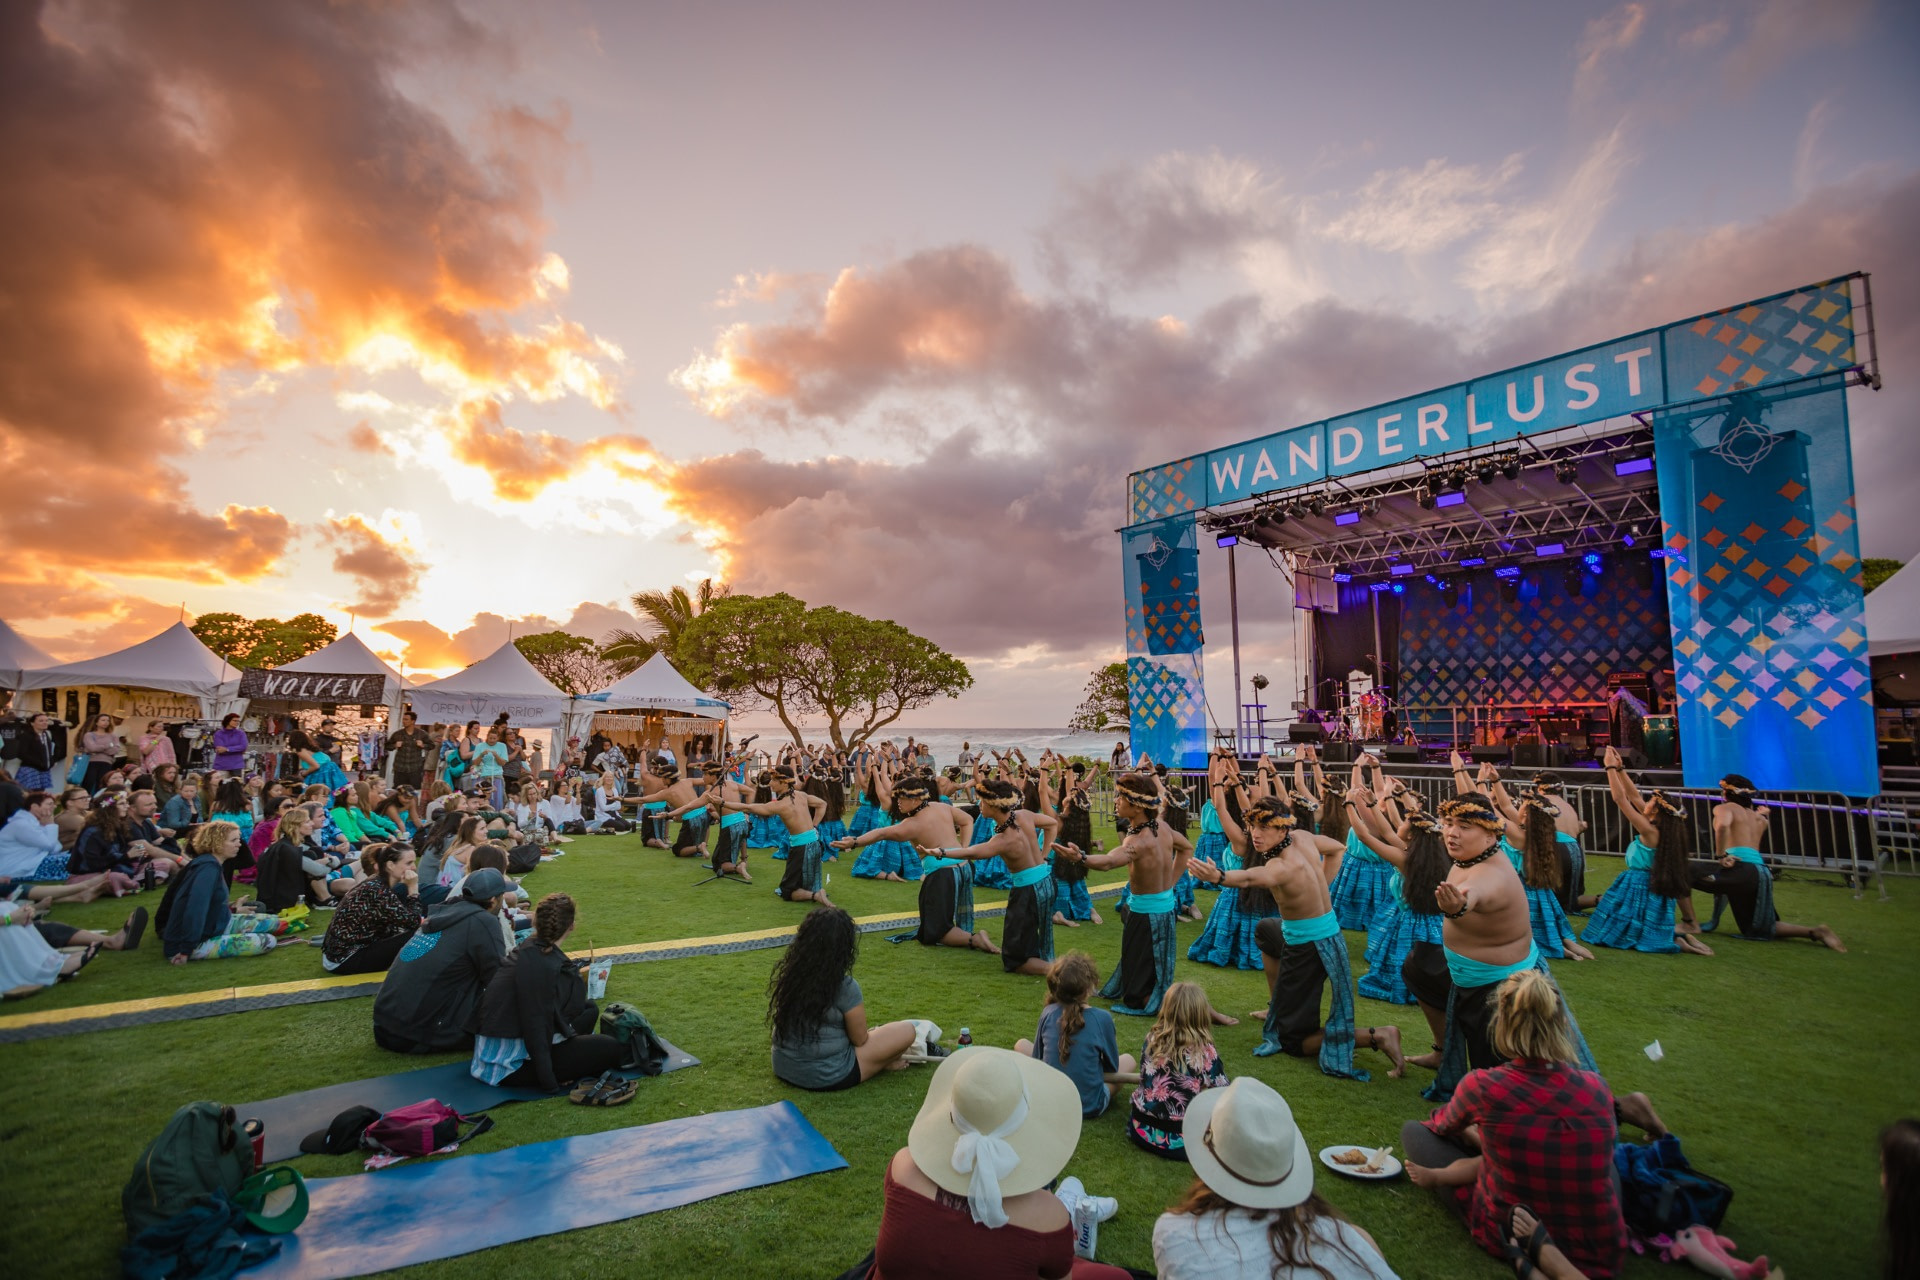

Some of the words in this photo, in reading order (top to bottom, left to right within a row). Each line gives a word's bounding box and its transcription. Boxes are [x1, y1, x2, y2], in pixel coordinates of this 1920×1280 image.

[1211, 347, 1652, 494] WANDERLUST
[263, 673, 367, 698] WOLVEN
[430, 702, 464, 714] OPEN
[491, 705, 544, 718] WARRIOR
[1079, 1220, 1090, 1250] flow
